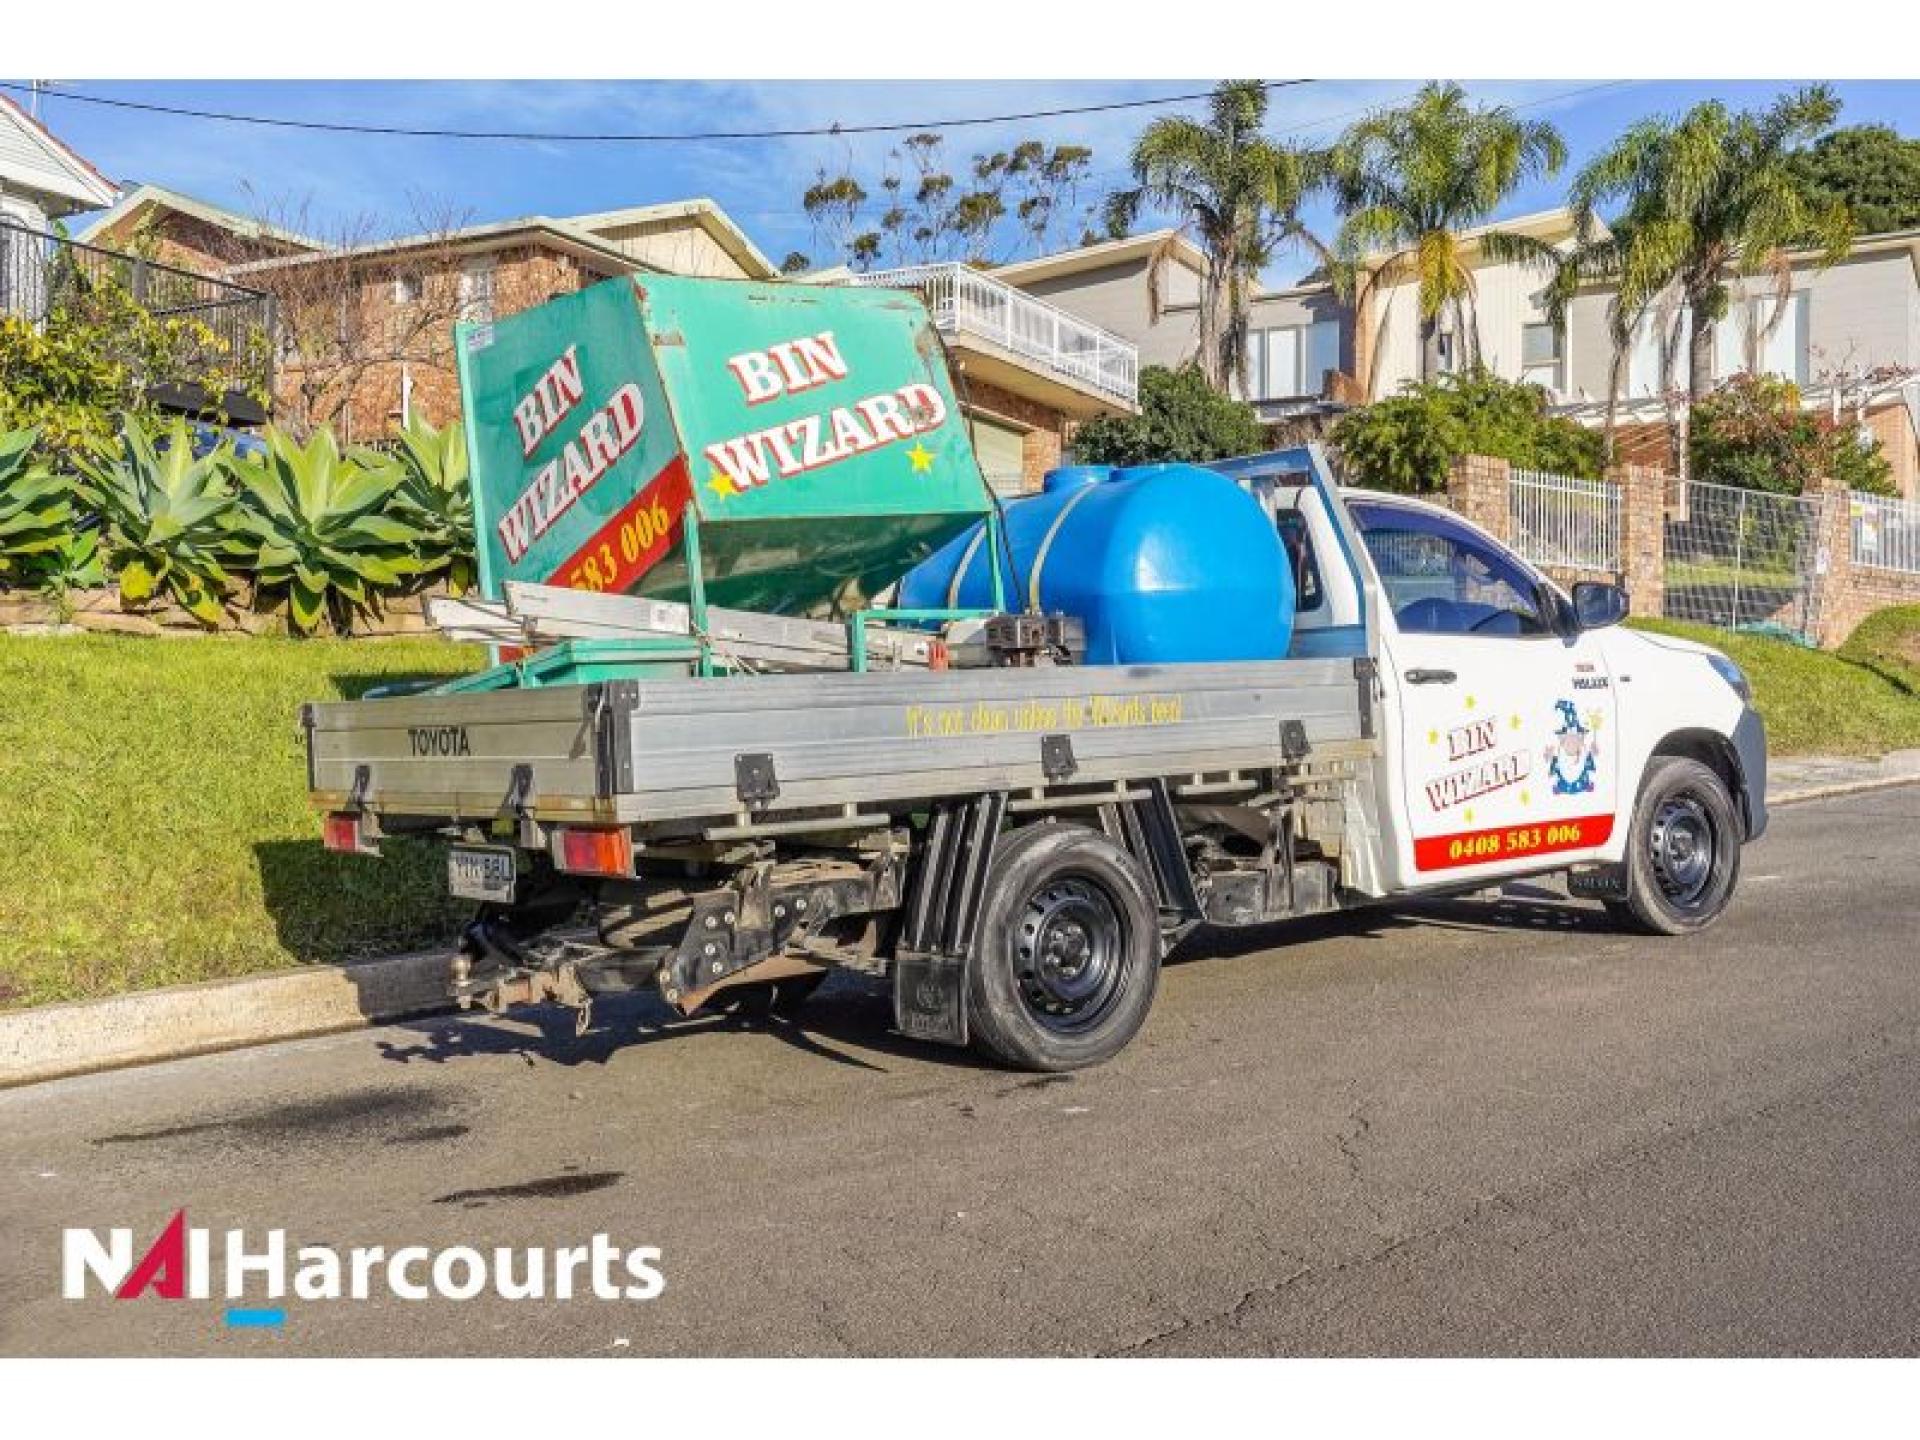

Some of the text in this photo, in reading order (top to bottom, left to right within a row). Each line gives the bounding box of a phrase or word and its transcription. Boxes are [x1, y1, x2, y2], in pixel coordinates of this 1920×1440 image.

[514, 345, 585, 457] BIN
[727, 332, 848, 404] BIN
[704, 383, 947, 493] WIZARD
[499, 383, 645, 565] WIZARD
[621, 496, 670, 565] 006
[407, 726, 471, 757] TOYOTA
[1447, 716, 1497, 761] BIN
[1425, 750, 1531, 811] WIZARD
[1450, 825, 1580, 860] 0408 583 006
